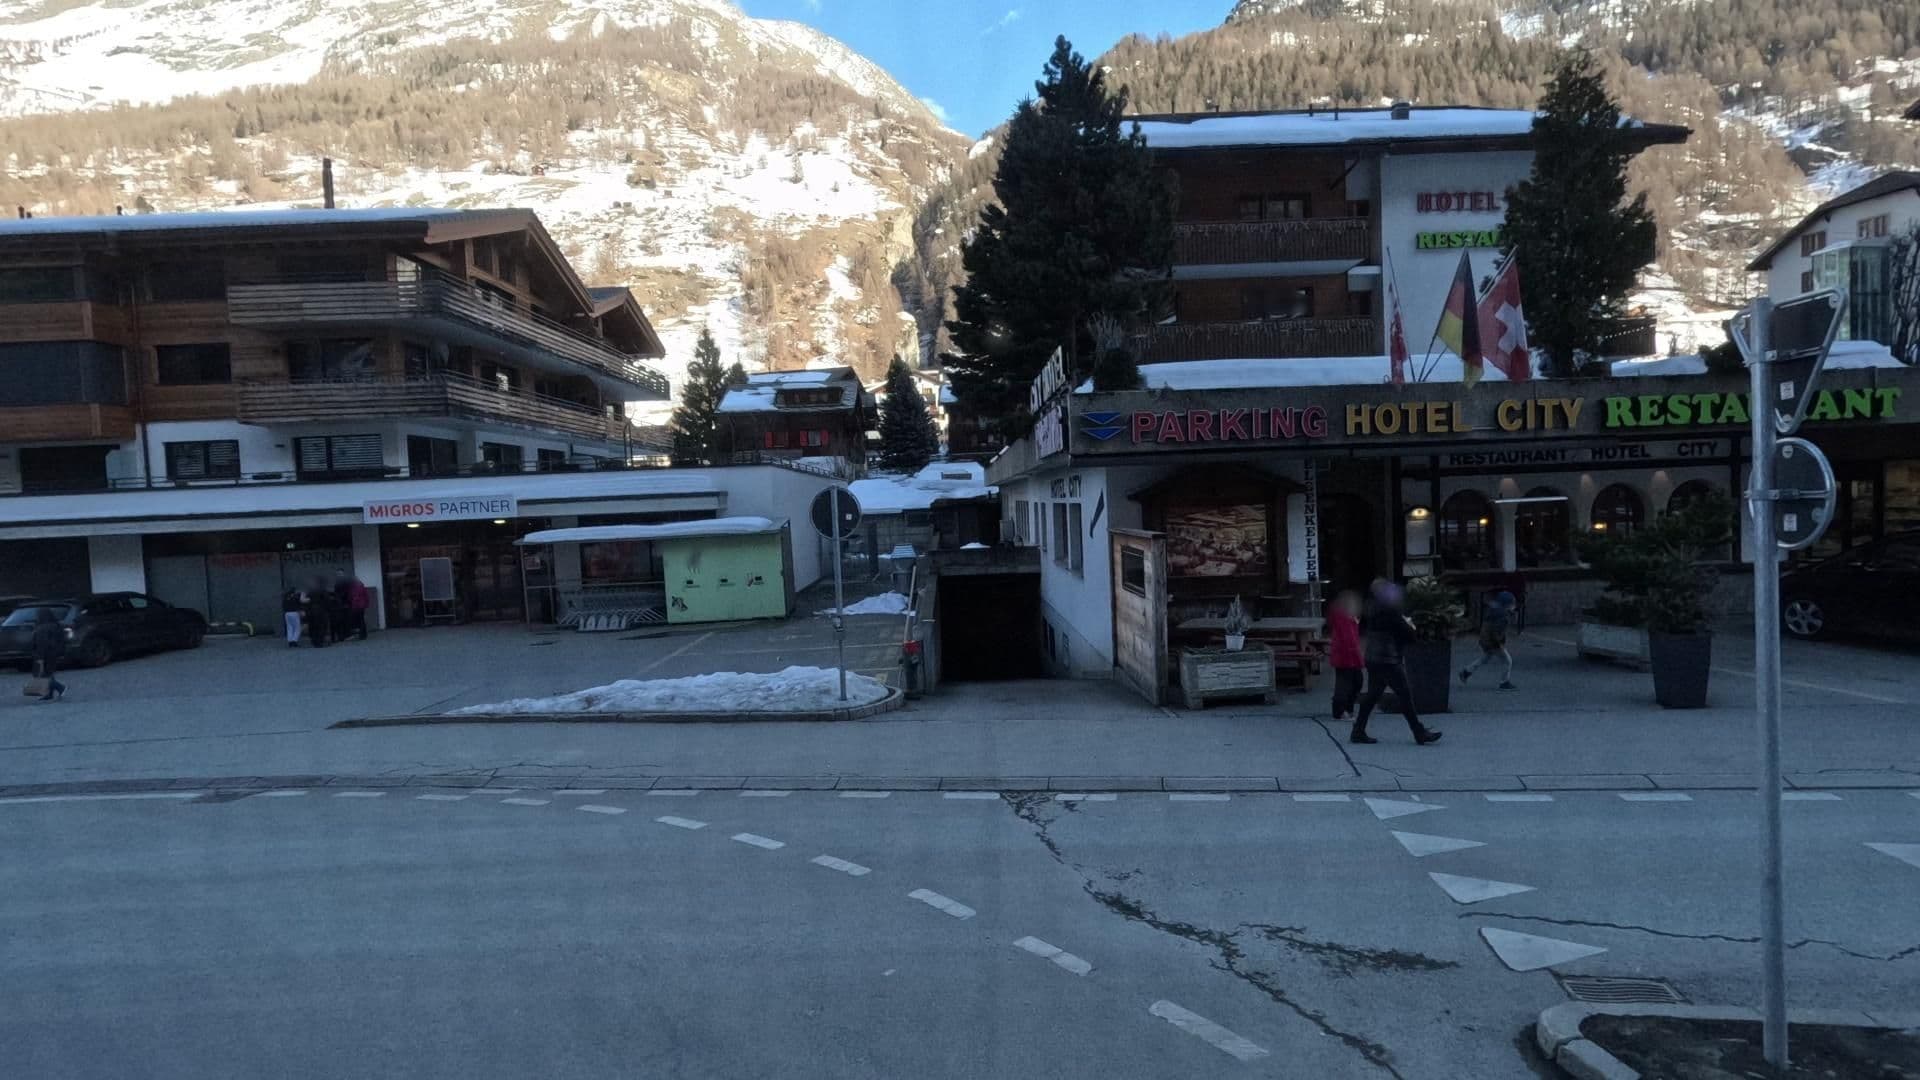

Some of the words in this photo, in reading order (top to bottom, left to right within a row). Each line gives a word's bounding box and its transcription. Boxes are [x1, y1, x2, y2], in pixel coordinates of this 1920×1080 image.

[1417, 192, 1502, 213] HOTEL
[1346, 400, 1473, 435] HOTEL
[1496, 396, 1584, 432] CITY
[1605, 391, 1902, 426] RESTAANT
[1131, 405, 1328, 444] PARKING
[1449, 447, 1568, 466] RESTAURANT
[1591, 443, 1651, 460] HOTEL
[1677, 441, 1718, 457] CITY
[369, 502, 435, 518] MIGROS
[439, 499, 511, 515] PARTNER
